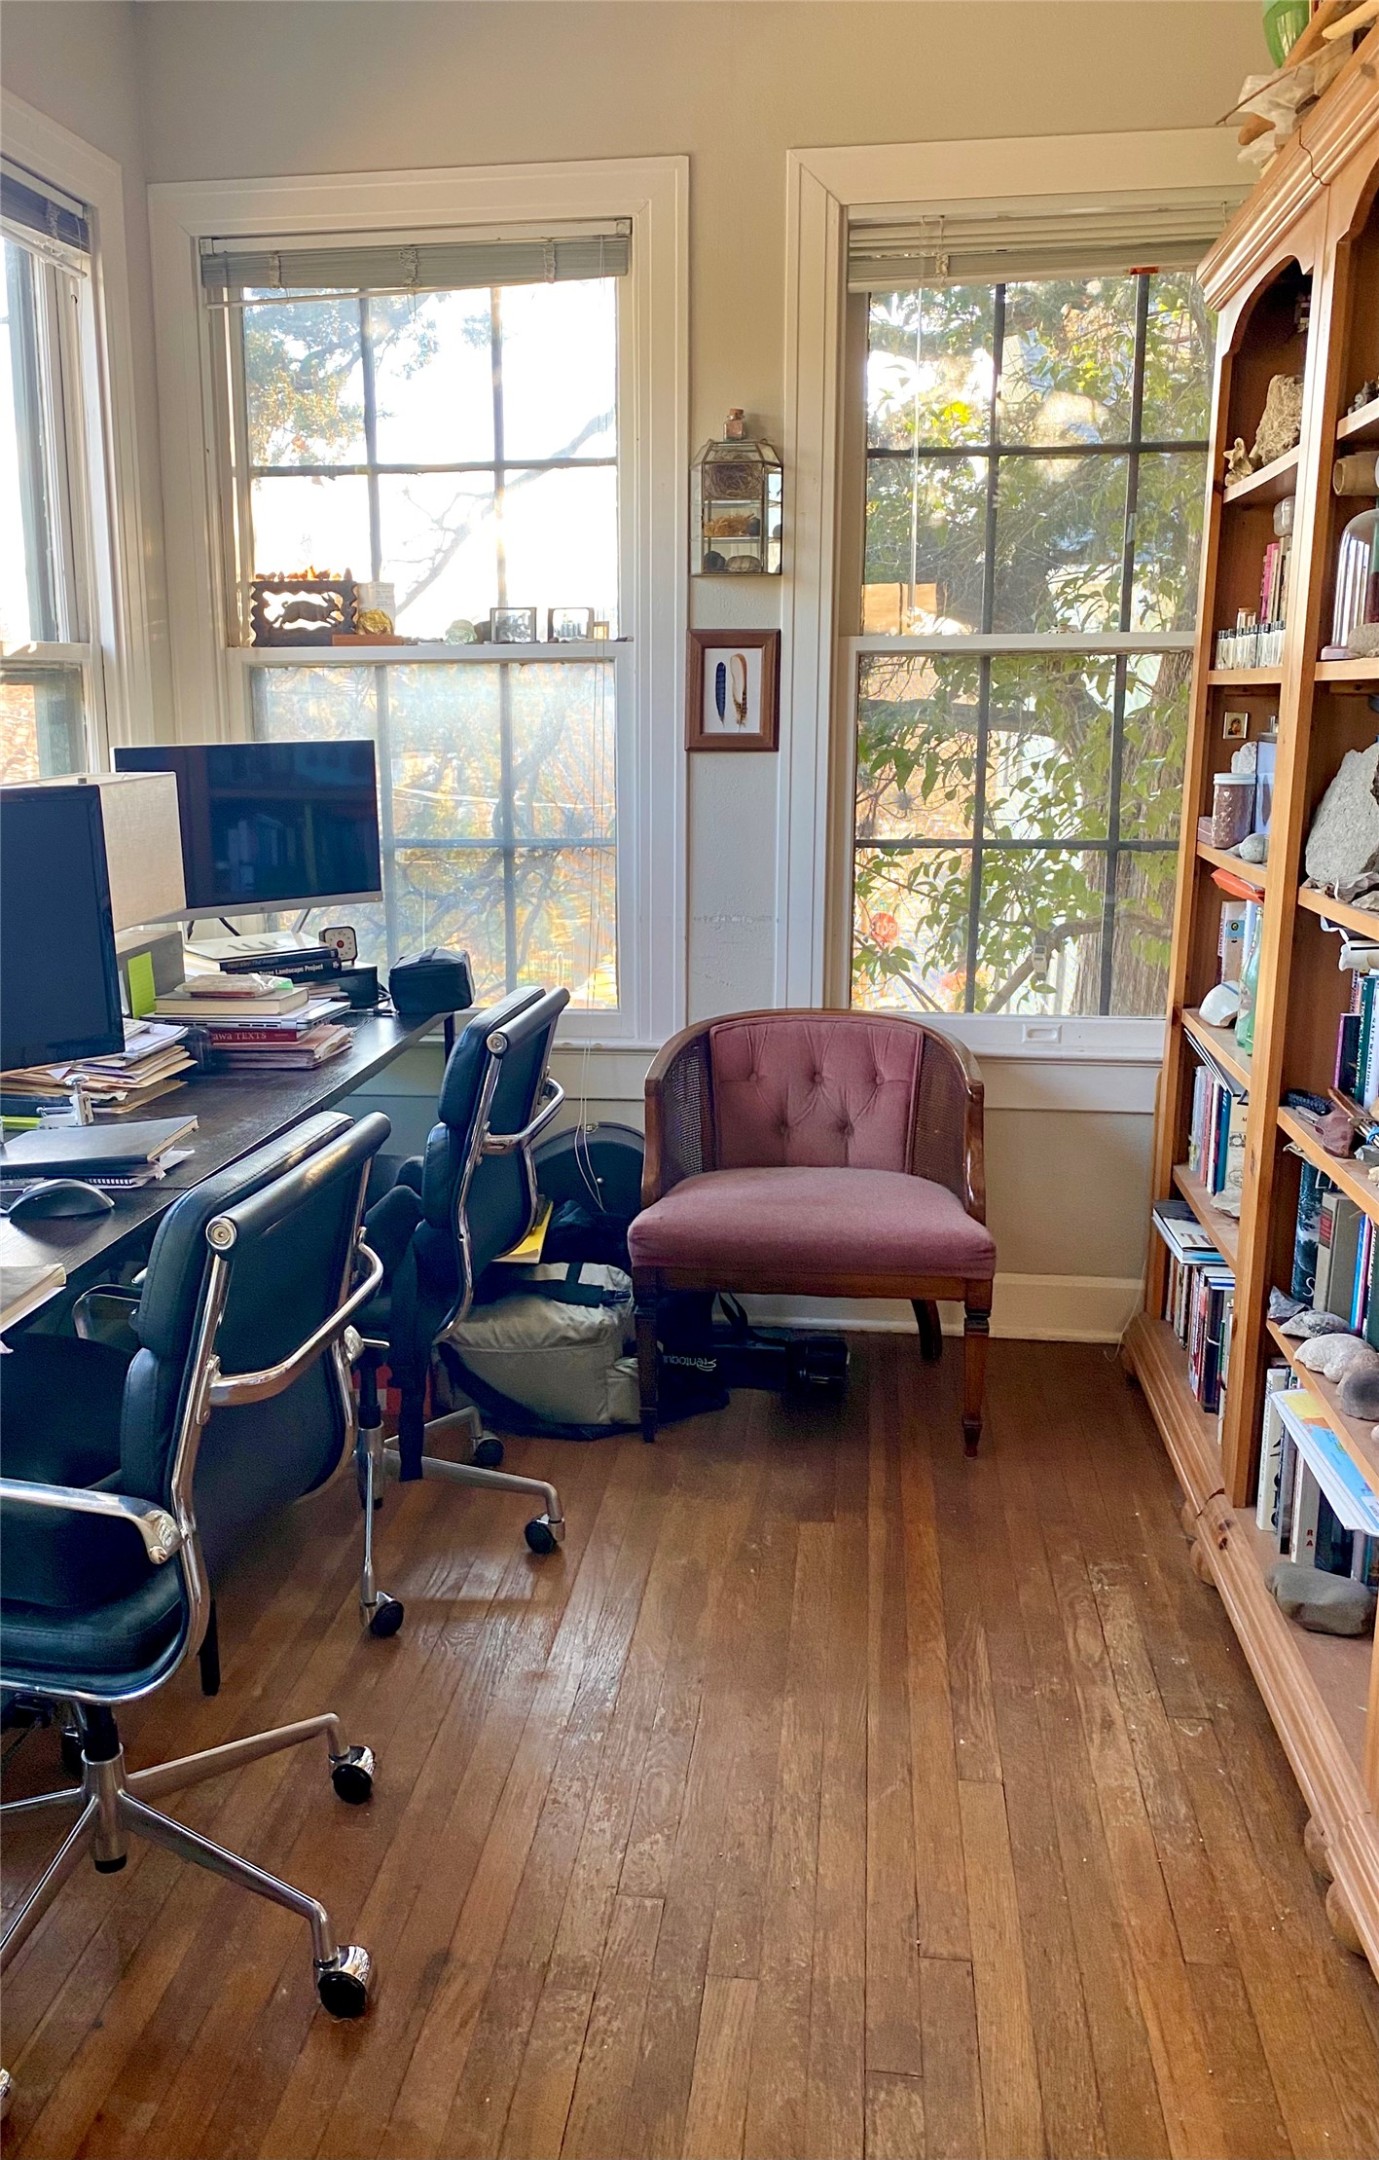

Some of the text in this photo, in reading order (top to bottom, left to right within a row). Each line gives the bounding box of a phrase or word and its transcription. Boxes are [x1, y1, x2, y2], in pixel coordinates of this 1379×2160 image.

[275, 966, 304, 976] Landscape
[304, 964, 324, 974] Project
[235, 1032, 267, 1040] TEXTS
